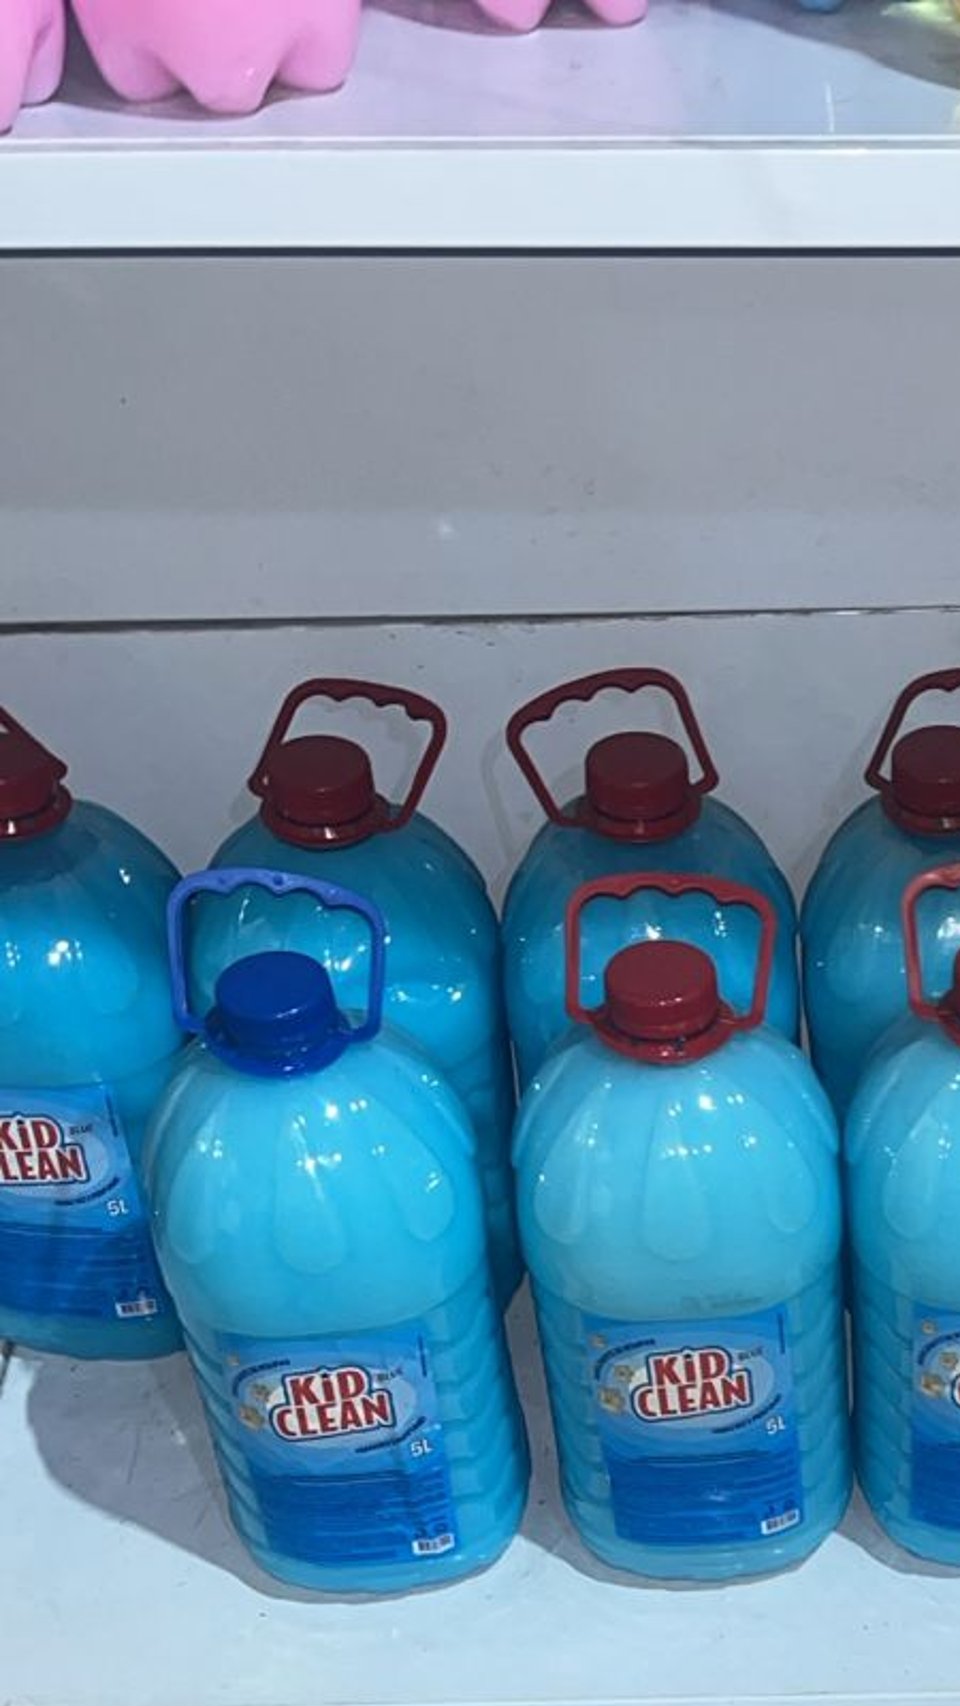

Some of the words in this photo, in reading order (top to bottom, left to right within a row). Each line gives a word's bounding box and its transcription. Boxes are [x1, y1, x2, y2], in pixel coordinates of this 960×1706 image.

[0, 1147, 84, 1181] LEAN
[274, 1392, 391, 1438] CLEAN
[636, 1372, 749, 1418] CLEAN
[410, 1438, 434, 1458] 5L
